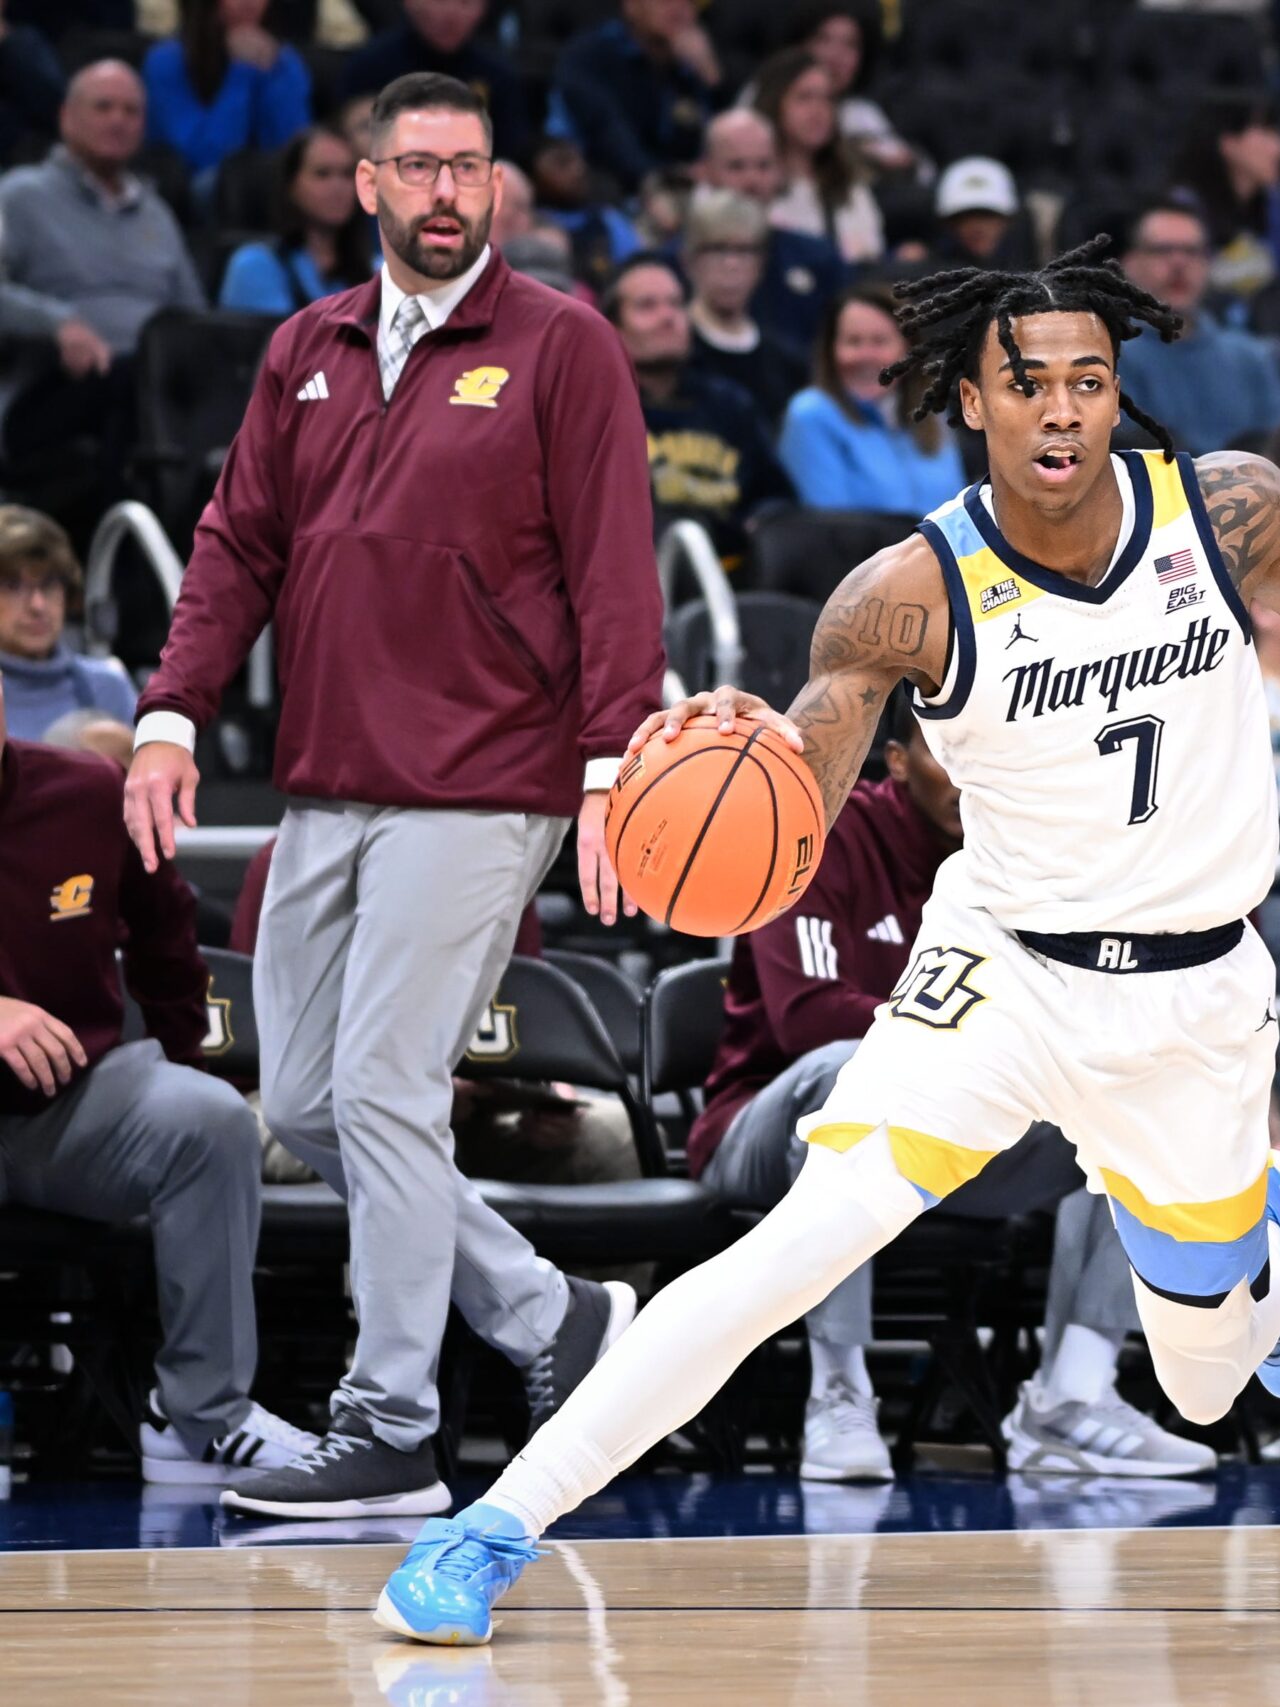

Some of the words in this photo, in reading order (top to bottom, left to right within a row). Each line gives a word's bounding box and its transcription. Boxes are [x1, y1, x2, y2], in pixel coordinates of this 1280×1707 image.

[981, 588, 995, 602] BE
[994, 578, 1015, 594] THE
[981, 586, 1021, 613] CHANGE
[1166, 589, 1207, 610] EAST
[1168, 582, 1197, 600] BIG
[1001, 615, 1231, 723] Marquette
[1093, 713, 1166, 826] 7
[1096, 937, 1139, 970] AL
